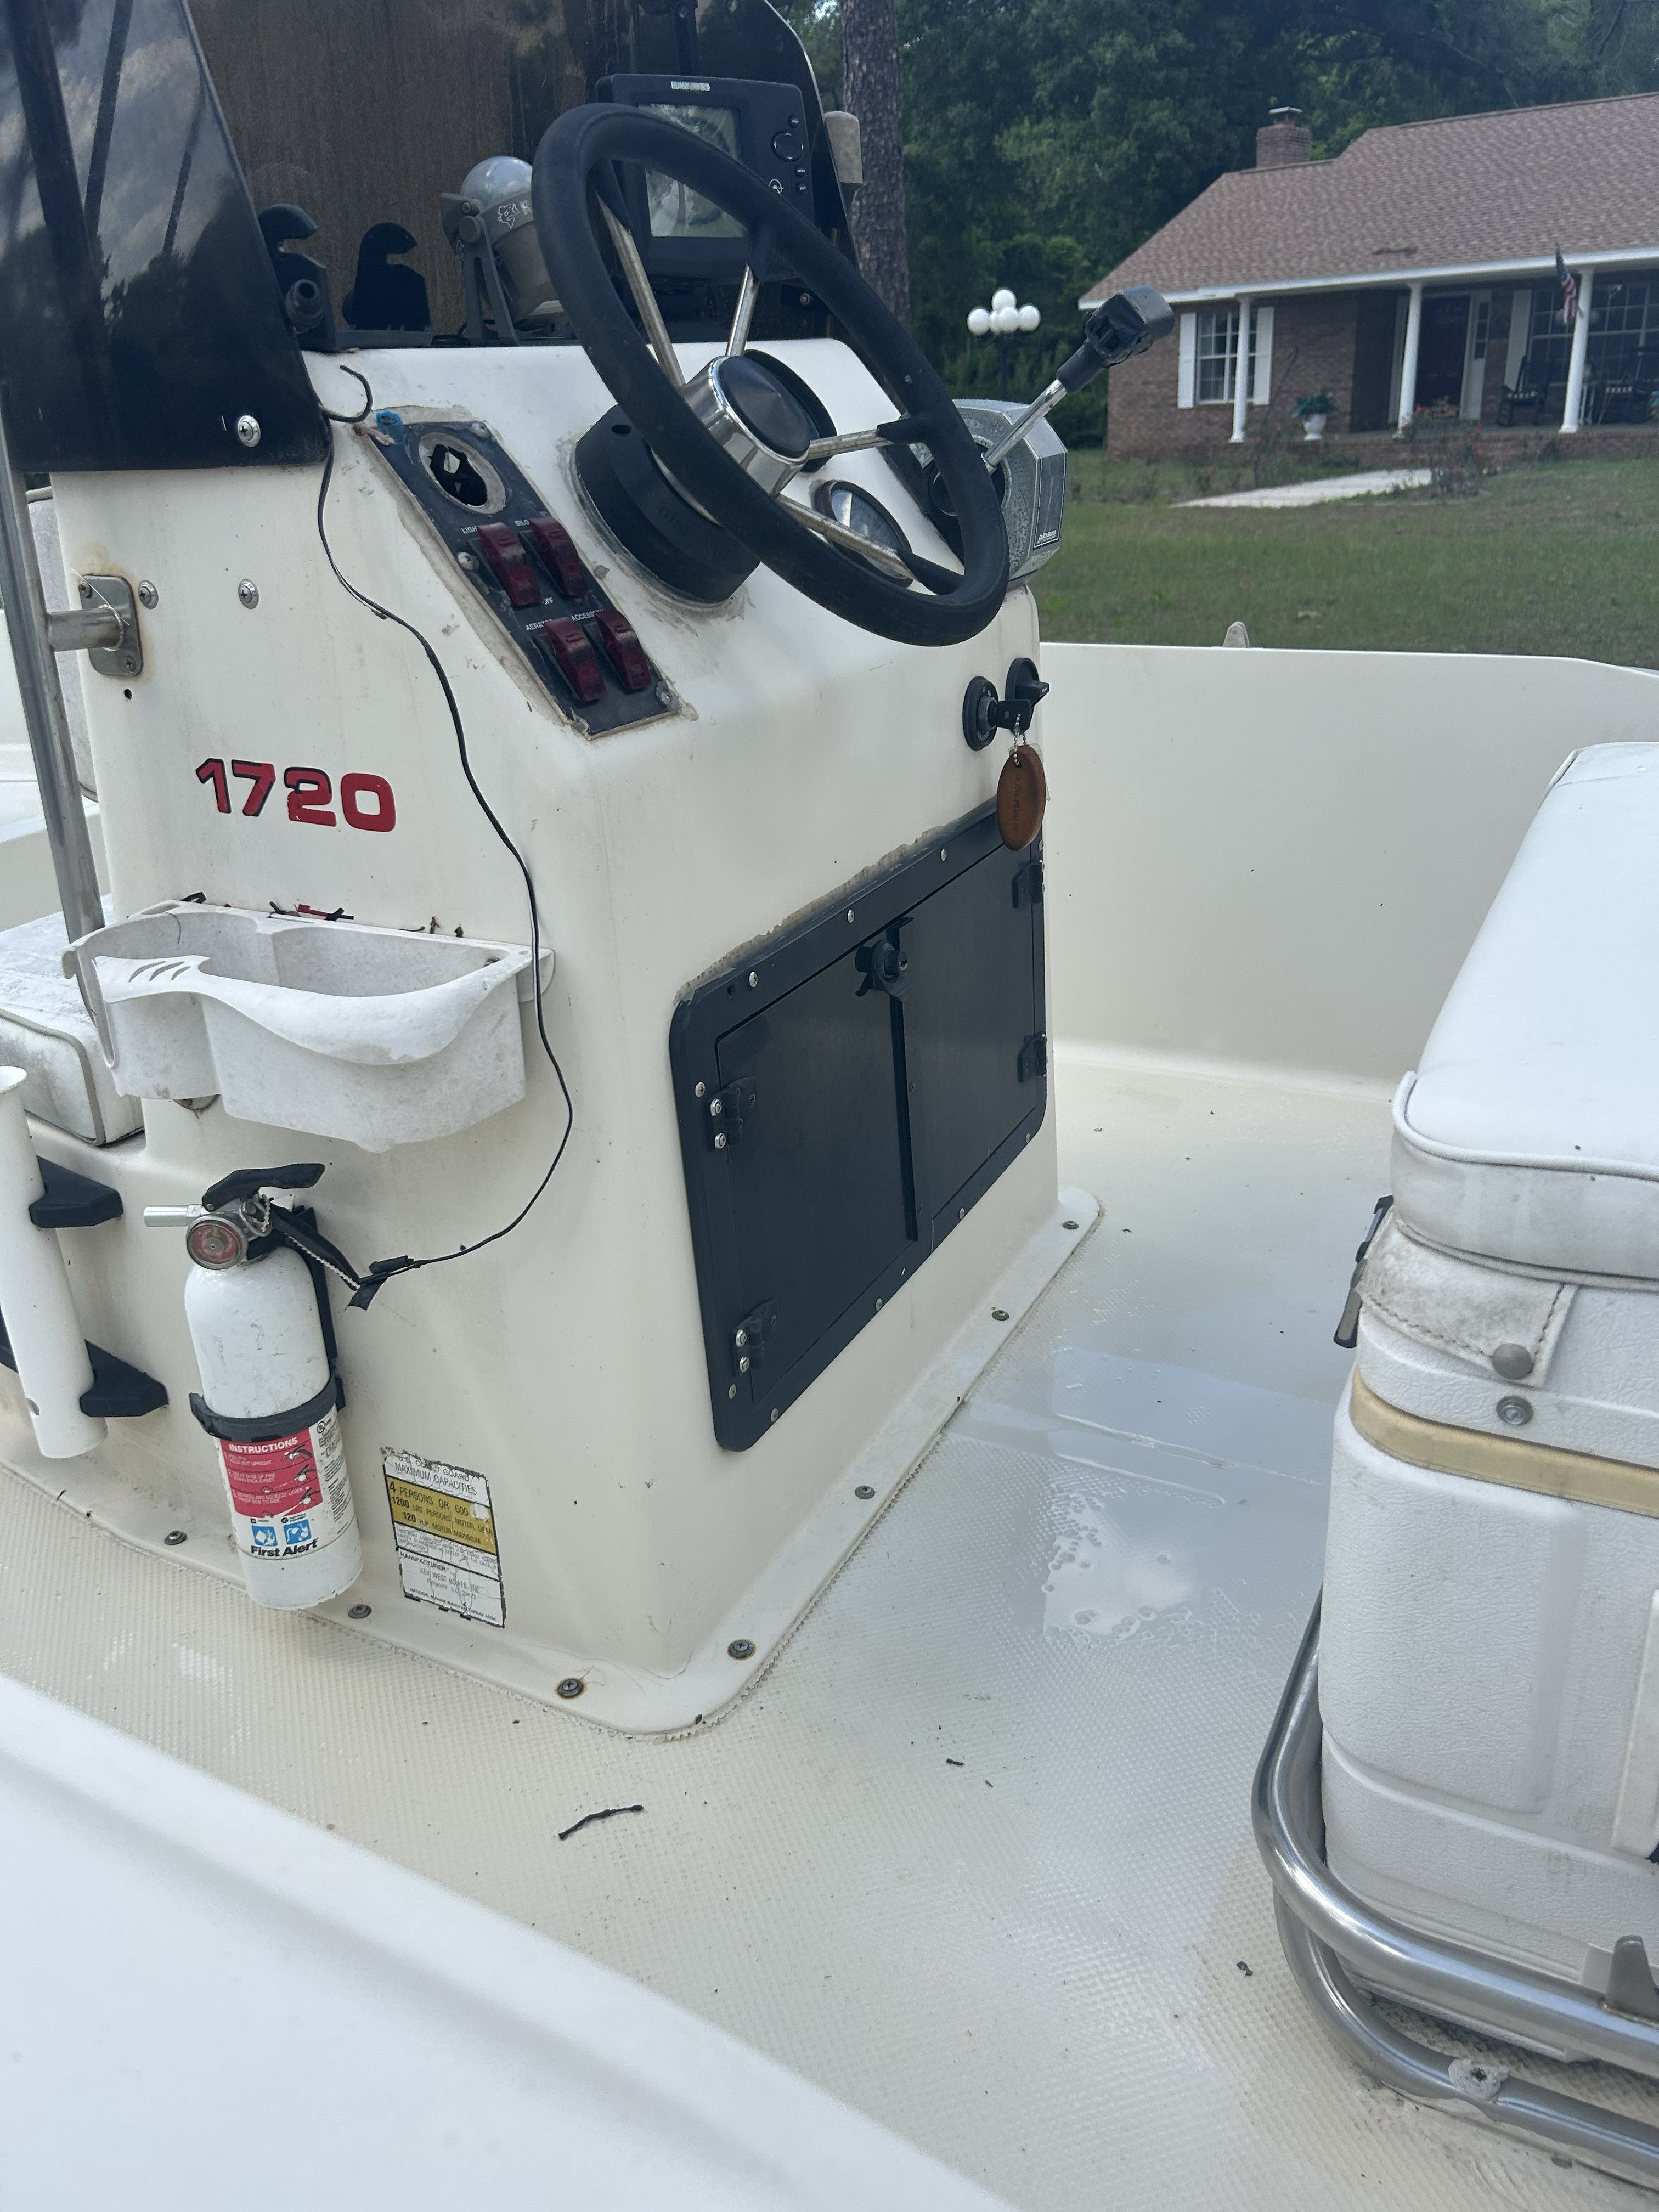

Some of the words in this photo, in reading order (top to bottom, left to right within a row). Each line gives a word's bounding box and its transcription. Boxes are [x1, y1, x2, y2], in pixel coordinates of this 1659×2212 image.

[461, 526, 478, 534] LIGH
[571, 608, 603, 622] ACCESS
[195, 758, 397, 833] 1720
[228, 1436, 298, 1454] INSTRUCTIONS
[395, 1462, 431, 1481] MAXIMUM
[433, 1474, 477, 1496] CAPACITIES
[443, 1468, 470, 1482] GUARD
[390, 1481, 397, 1493] 4
[399, 1486, 433, 1505] PERSONS
[438, 1498, 449, 1510] OR
[455, 1504, 469, 1516] 600
[391, 1496, 410, 1508] 1200
[402, 1511, 417, 1522] 120
[432, 1522, 452, 1534] MOTOR
[453, 1529, 481, 1544] MAXIMUM
[251, 1544, 280, 1557] First
[283, 1538, 317, 1556] Alert
[432, 1571, 447, 1582] WEST
